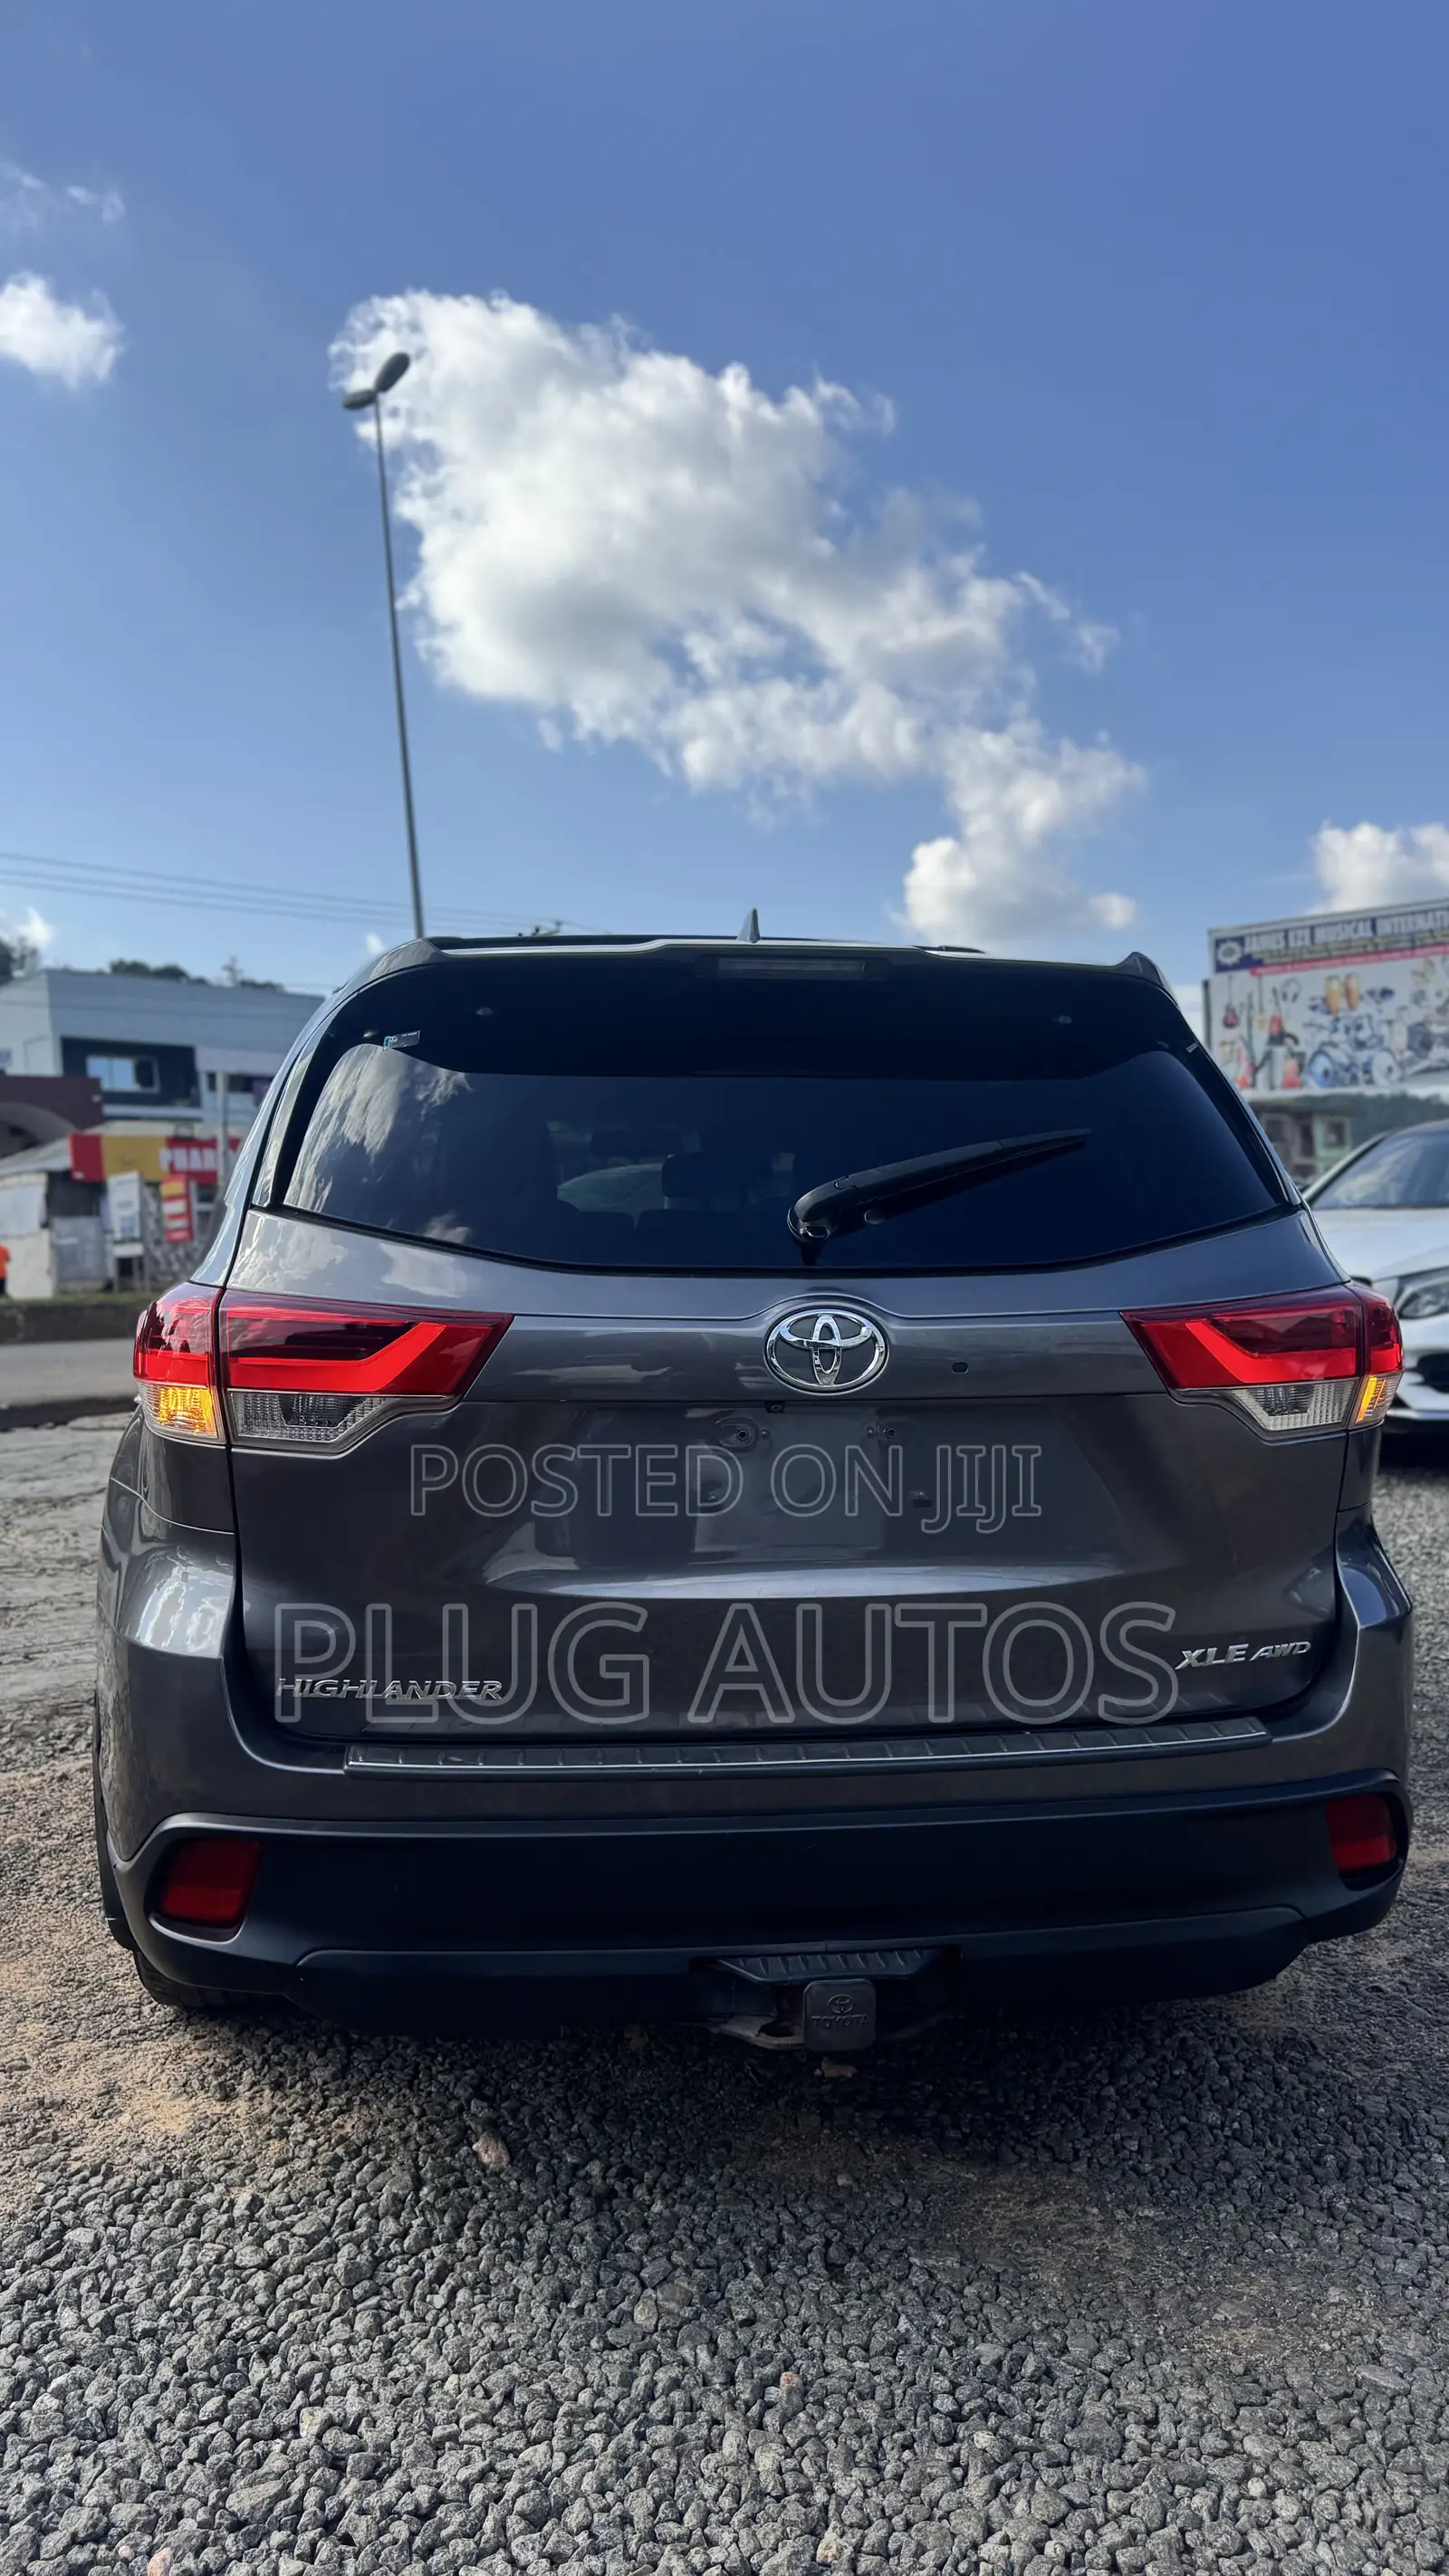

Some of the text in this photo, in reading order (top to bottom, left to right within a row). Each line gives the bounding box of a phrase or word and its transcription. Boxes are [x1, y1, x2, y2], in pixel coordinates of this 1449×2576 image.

[1314, 920, 1372, 944] MUSICAL
[1175, 1641, 1311, 1670] XLE AWD
[275, 1678, 504, 1700] HIGHLANDER
[811, 2014, 870, 2027] TOYOTA
